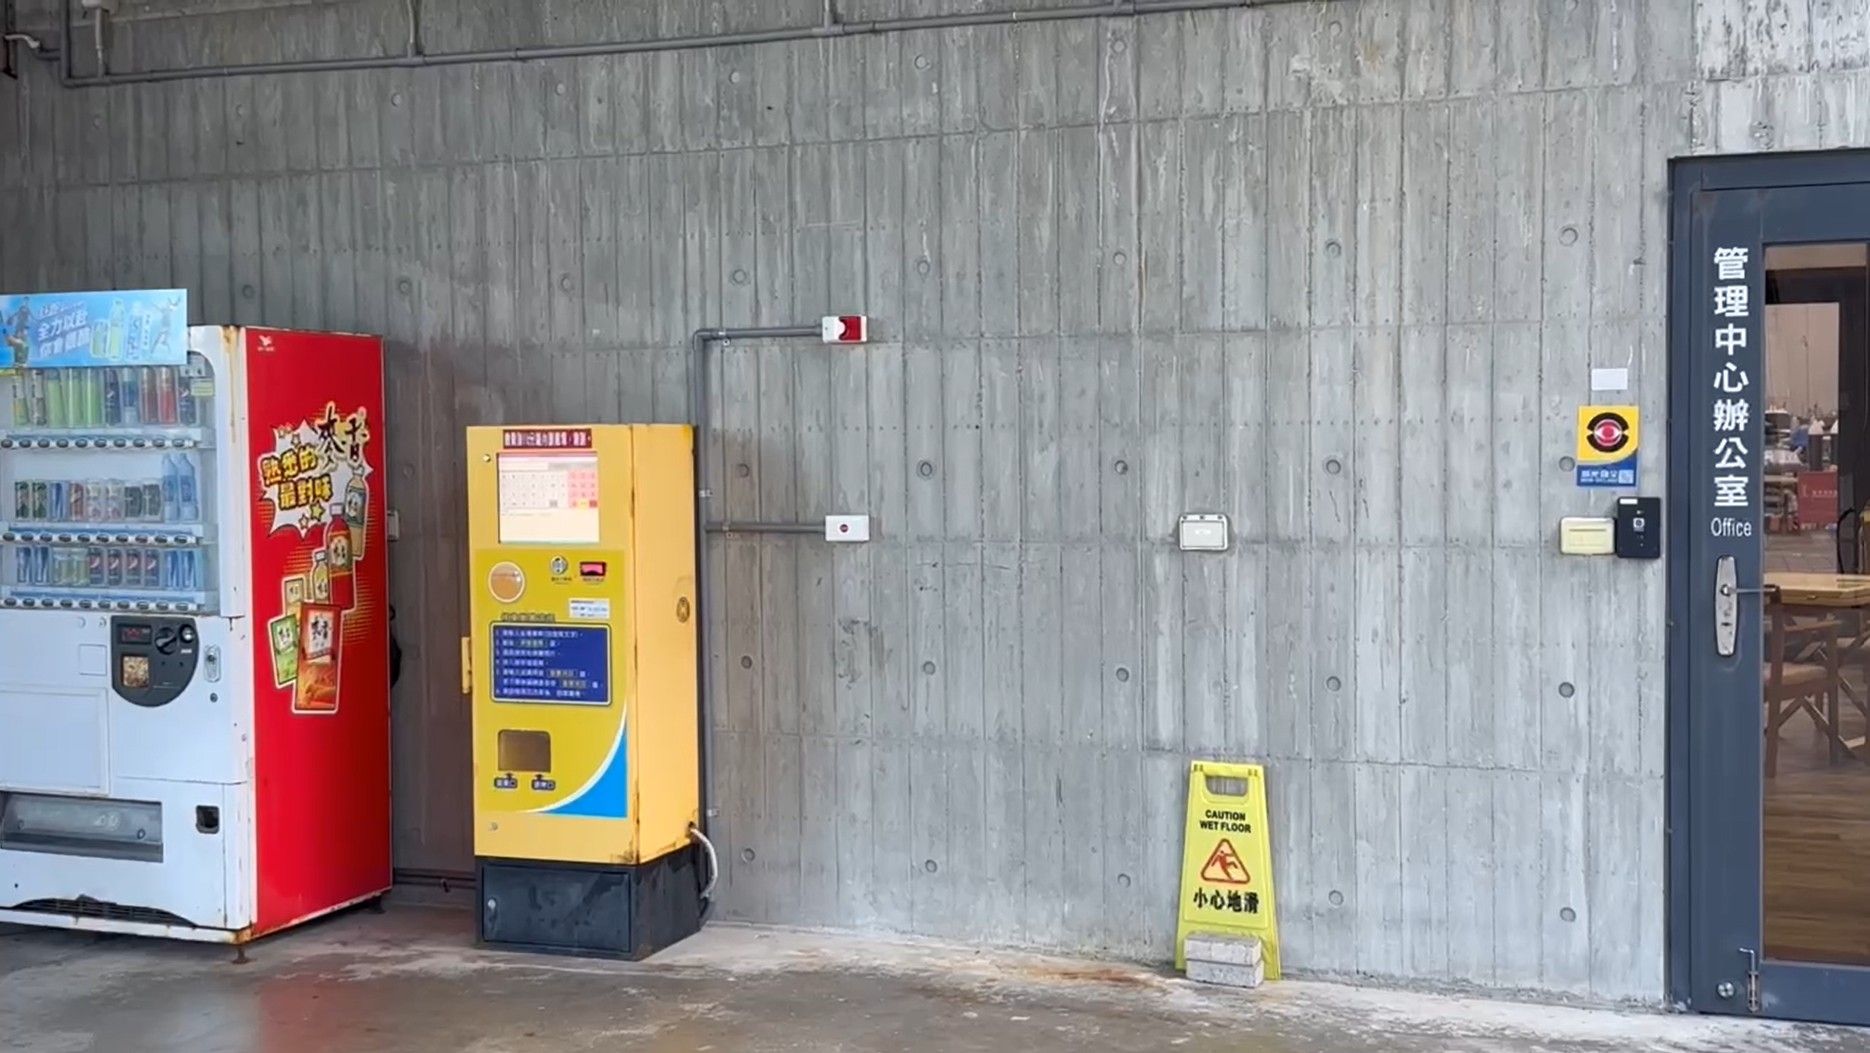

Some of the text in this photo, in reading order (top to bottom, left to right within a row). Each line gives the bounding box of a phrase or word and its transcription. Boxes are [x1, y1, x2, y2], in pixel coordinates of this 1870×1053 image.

[1713, 246, 1750, 508] 管理中心辦公室
[279, 475, 333, 510] 最對味
[1711, 517, 1752, 537] Office
[1199, 820, 1251, 834] WET FLOOR
[1205, 809, 1246, 822] CAUTION
[1193, 887, 1259, 914] 小心地滑
